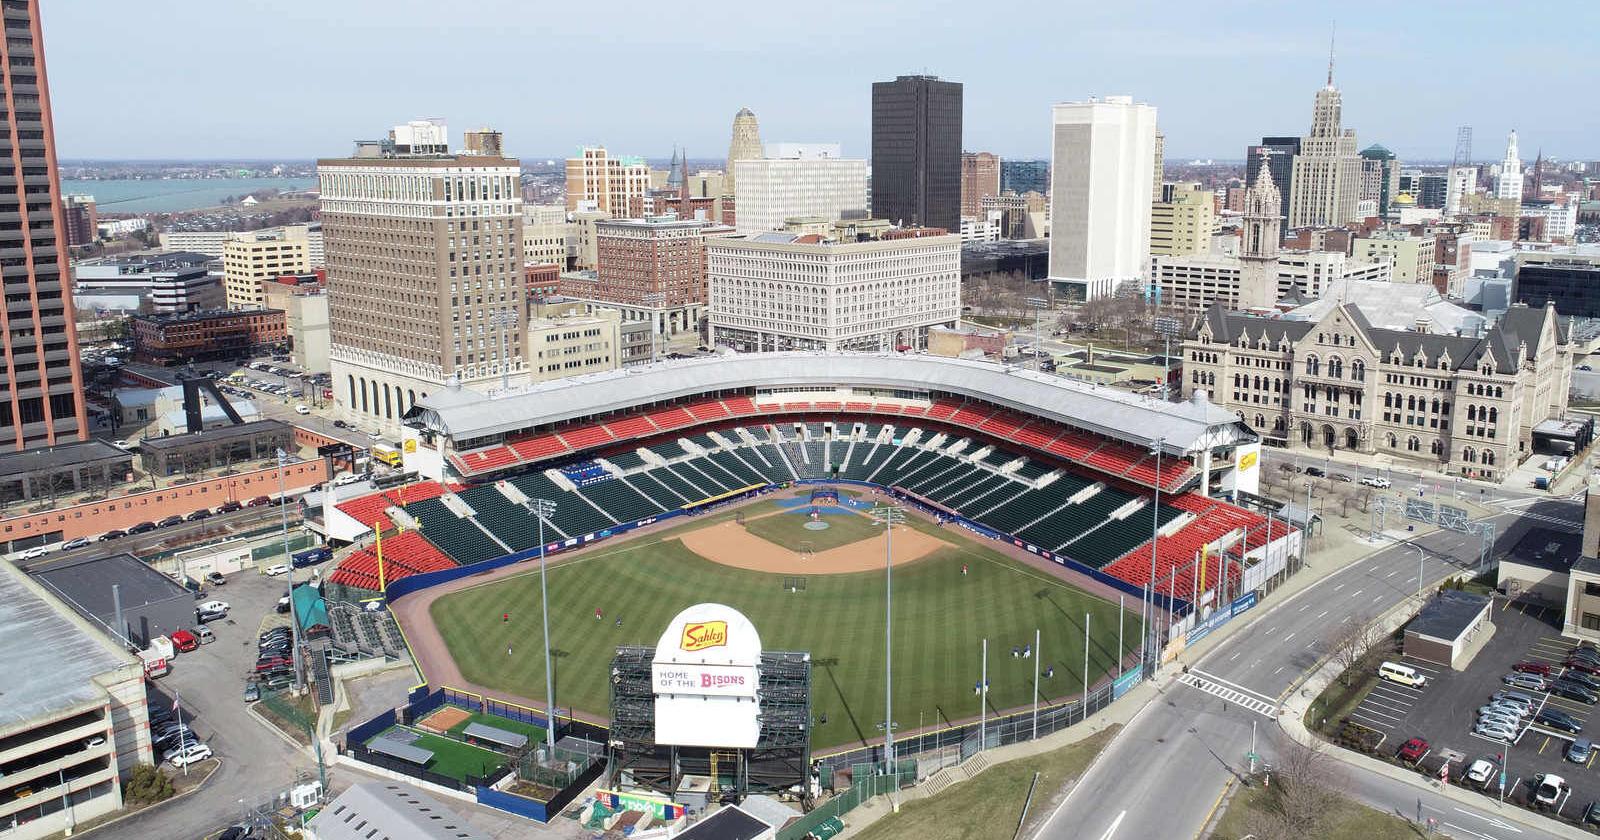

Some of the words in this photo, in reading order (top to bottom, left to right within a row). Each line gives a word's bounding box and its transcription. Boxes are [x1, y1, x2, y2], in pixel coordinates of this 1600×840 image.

[660, 671, 688, 679] HOME
[660, 679, 673, 687] OF
[677, 680, 695, 688] THE
[701, 673, 745, 688] BISONS
